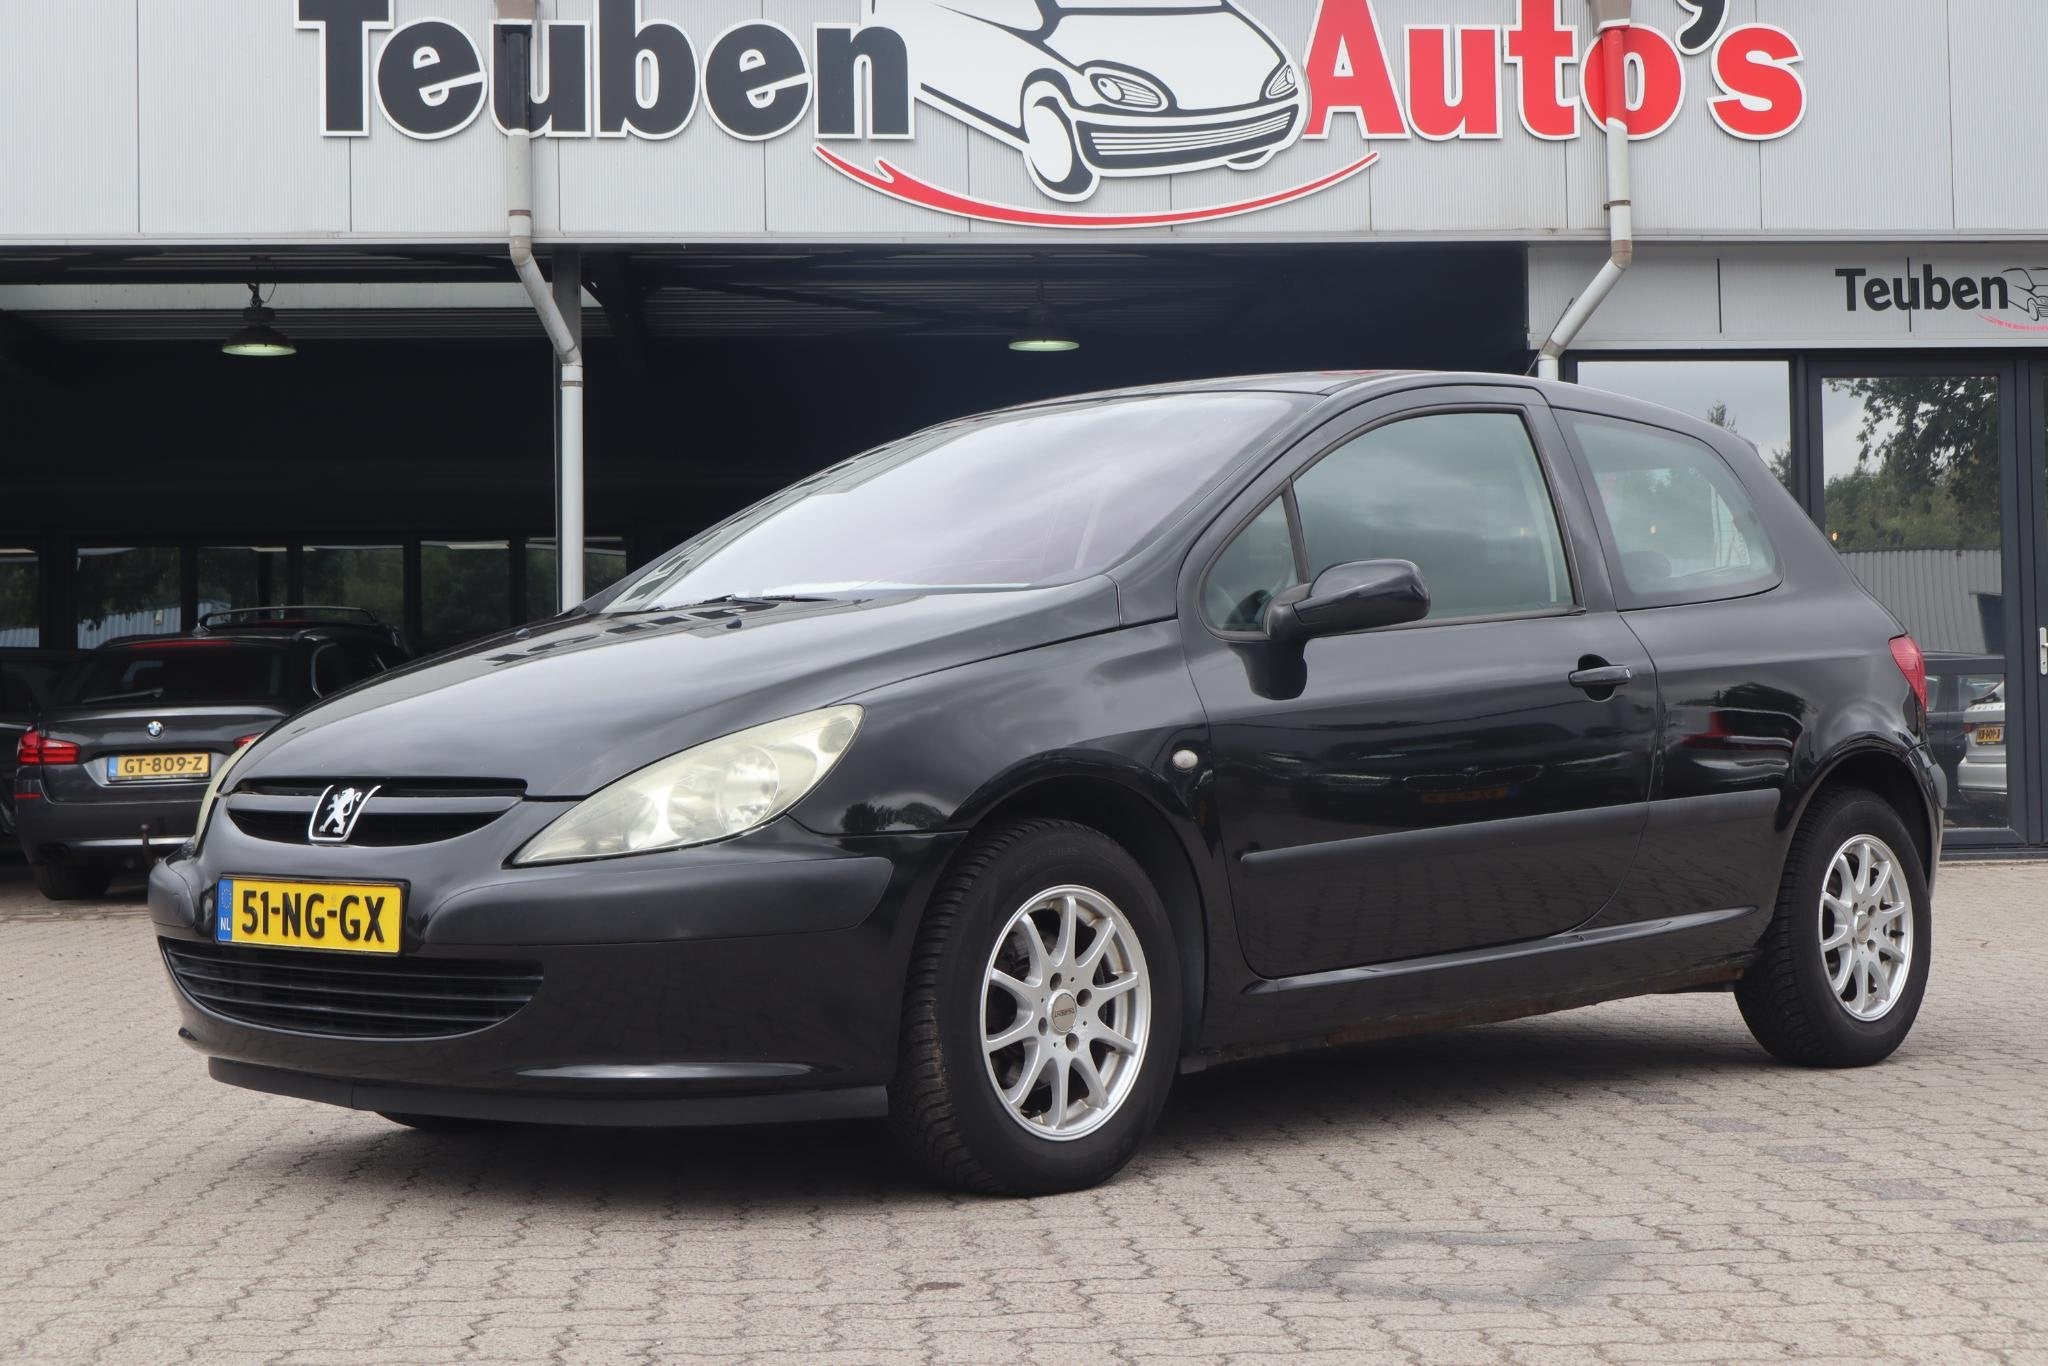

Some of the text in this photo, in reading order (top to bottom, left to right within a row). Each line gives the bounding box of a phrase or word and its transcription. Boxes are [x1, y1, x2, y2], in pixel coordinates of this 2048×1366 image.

[297, 0, 1805, 138] Teuben Auto's
[1835, 264, 2009, 312] Teuben
[124, 757, 203, 773] GT-809-Z
[220, 917, 231, 931] NL
[242, 890, 385, 943] 51-NG-GX
